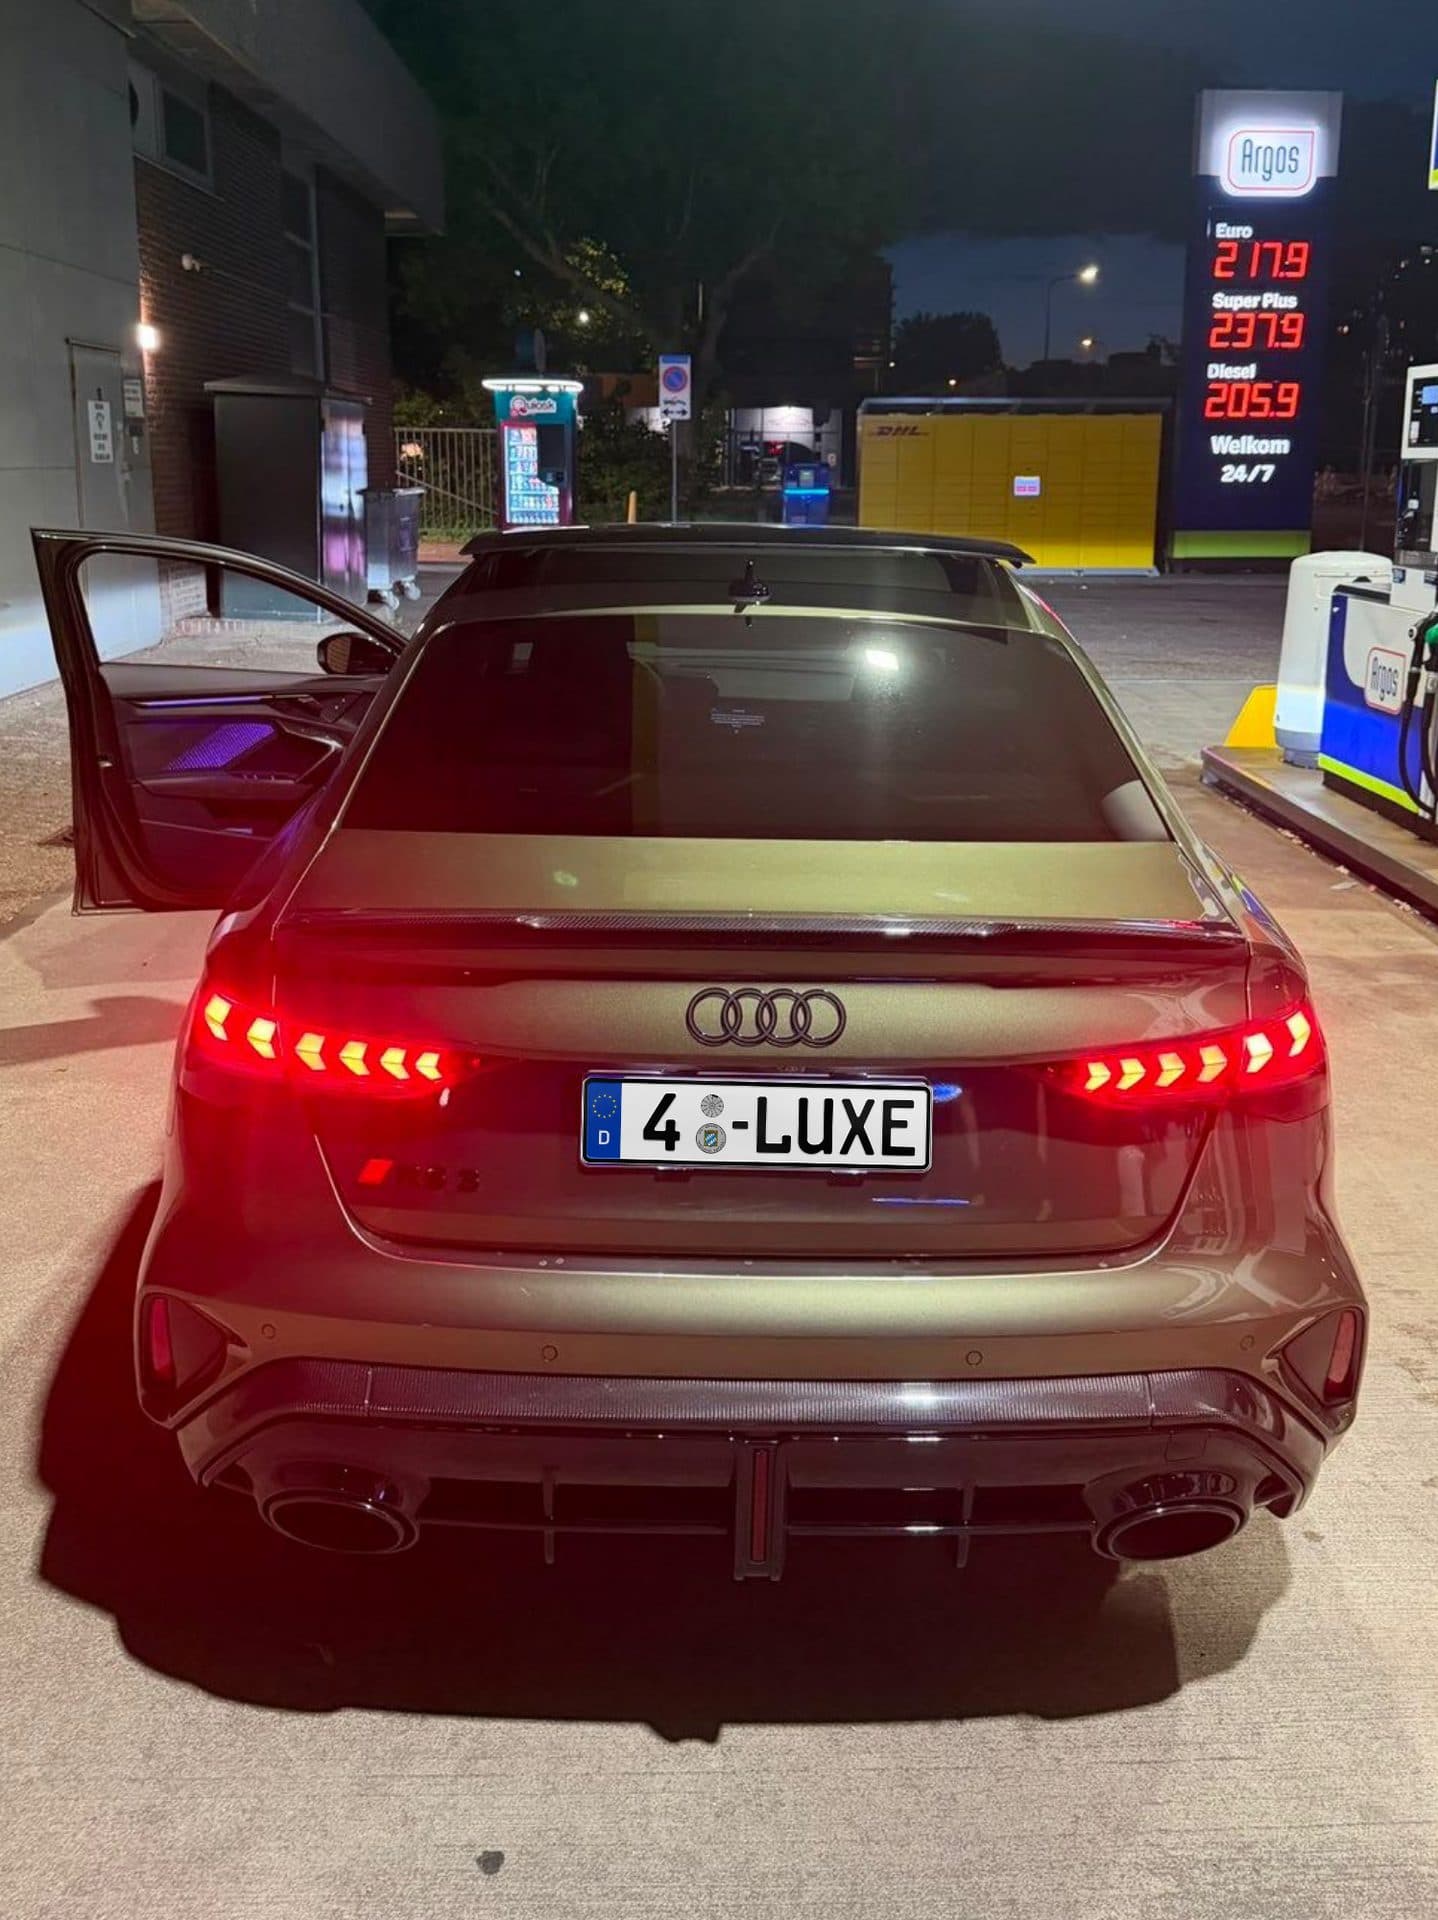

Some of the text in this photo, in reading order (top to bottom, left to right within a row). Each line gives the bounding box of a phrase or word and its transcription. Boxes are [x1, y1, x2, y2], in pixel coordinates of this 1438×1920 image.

[1241, 138, 1300, 181] Argos
[1215, 223, 1253, 239] Euro
[1213, 241, 1310, 279] 217.9
[1212, 293, 1298, 312] Super Plus
[1208, 312, 1305, 350] 237.9
[1207, 363, 1256, 380] Diesel
[1204, 383, 1299, 419] 205.9
[875, 426, 923, 436] DHL
[1211, 435, 1290, 455] Welkom
[1220, 464, 1276, 484] 24/7
[1371, 655, 1399, 702] Argos
[643, 1093, 681, 1151] 4
[598, 1130, 611, 1145] D
